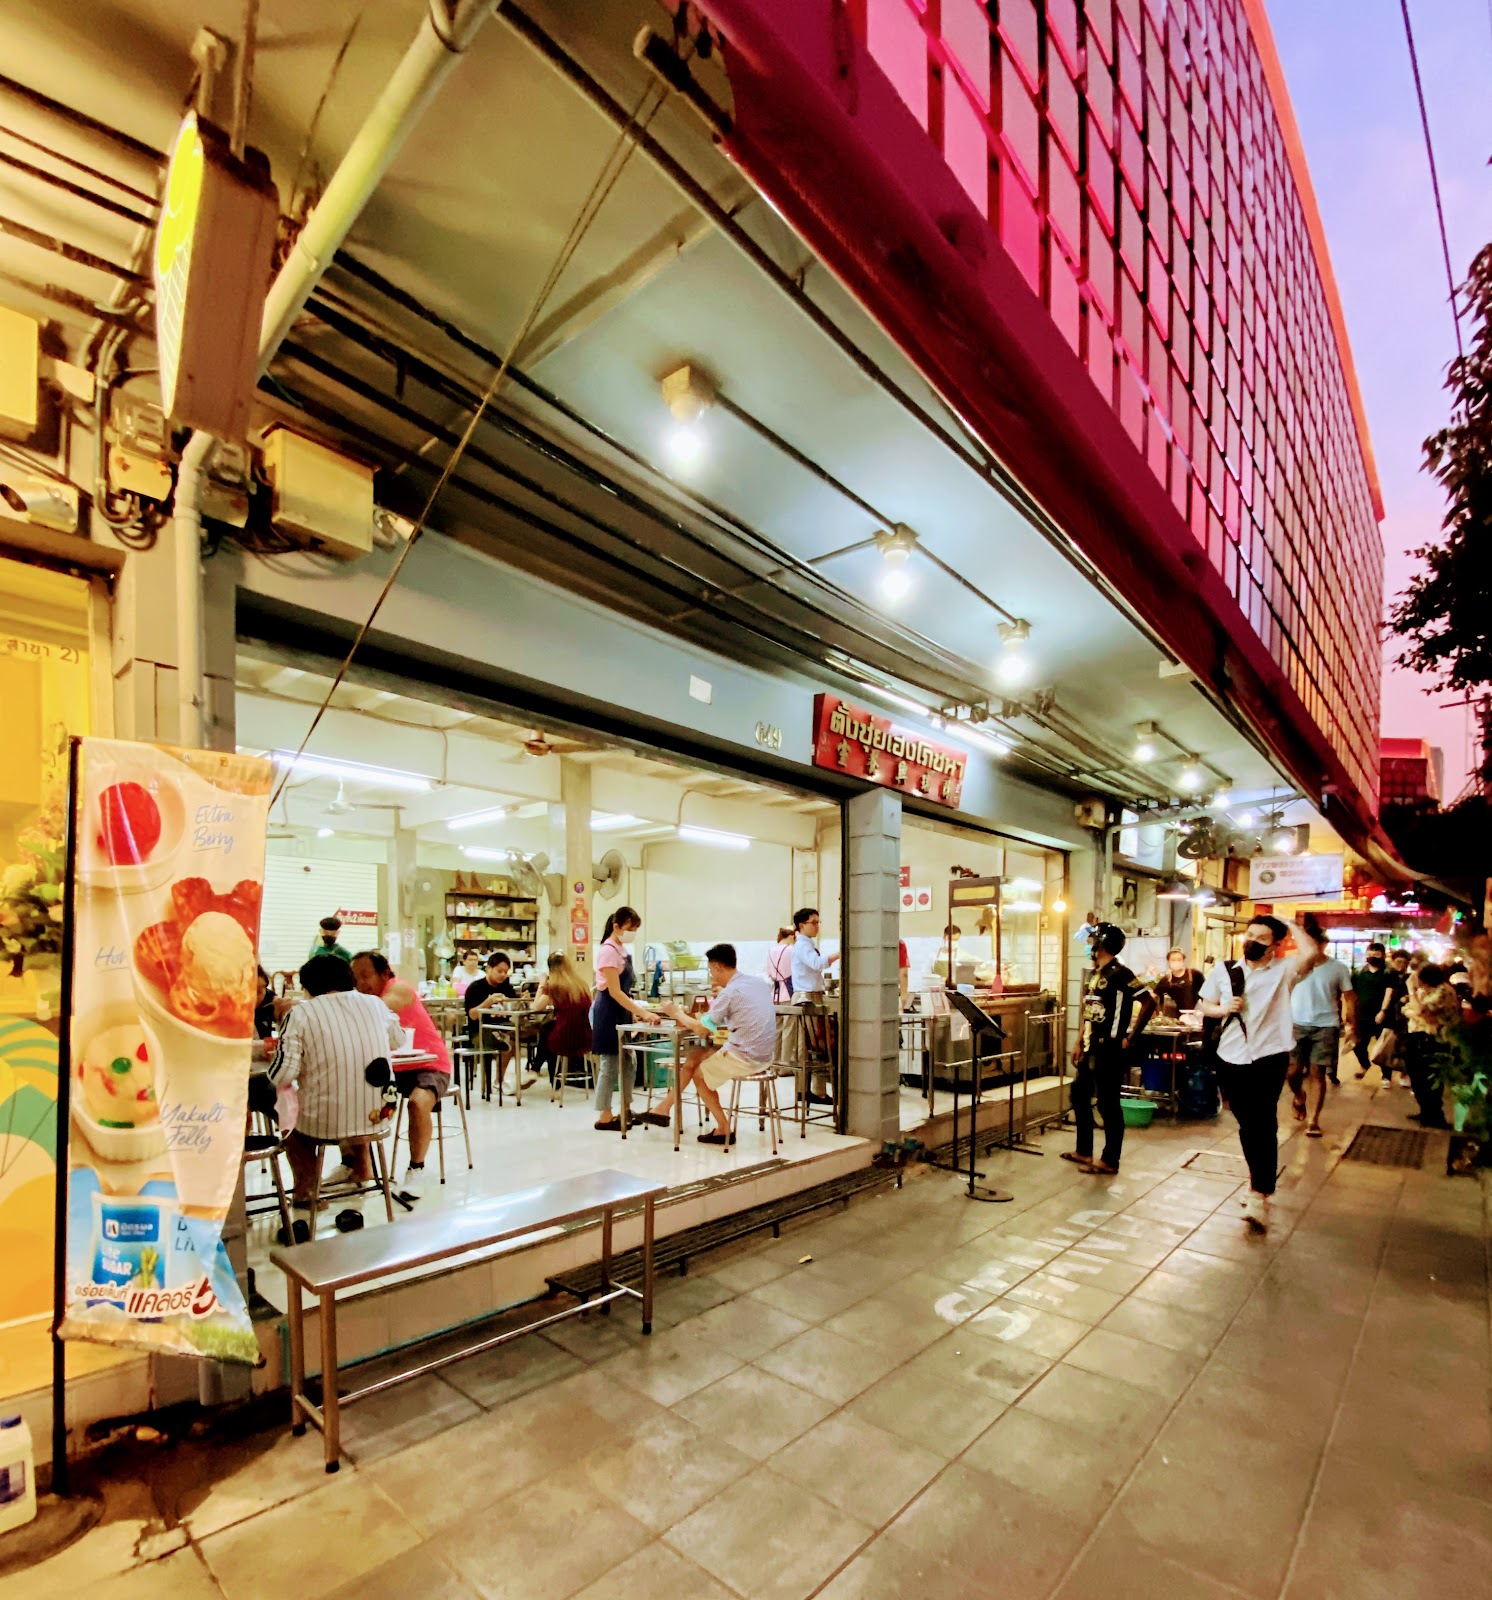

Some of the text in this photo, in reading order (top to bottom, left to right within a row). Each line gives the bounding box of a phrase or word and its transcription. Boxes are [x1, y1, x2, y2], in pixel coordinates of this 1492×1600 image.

[60, 646, 79, 665] 2)
[195, 804, 235, 825] Extra
[193, 825, 235, 854] Berry
[161, 1103, 231, 1128] Yakult
[167, 1125, 213, 1154] Jelly
